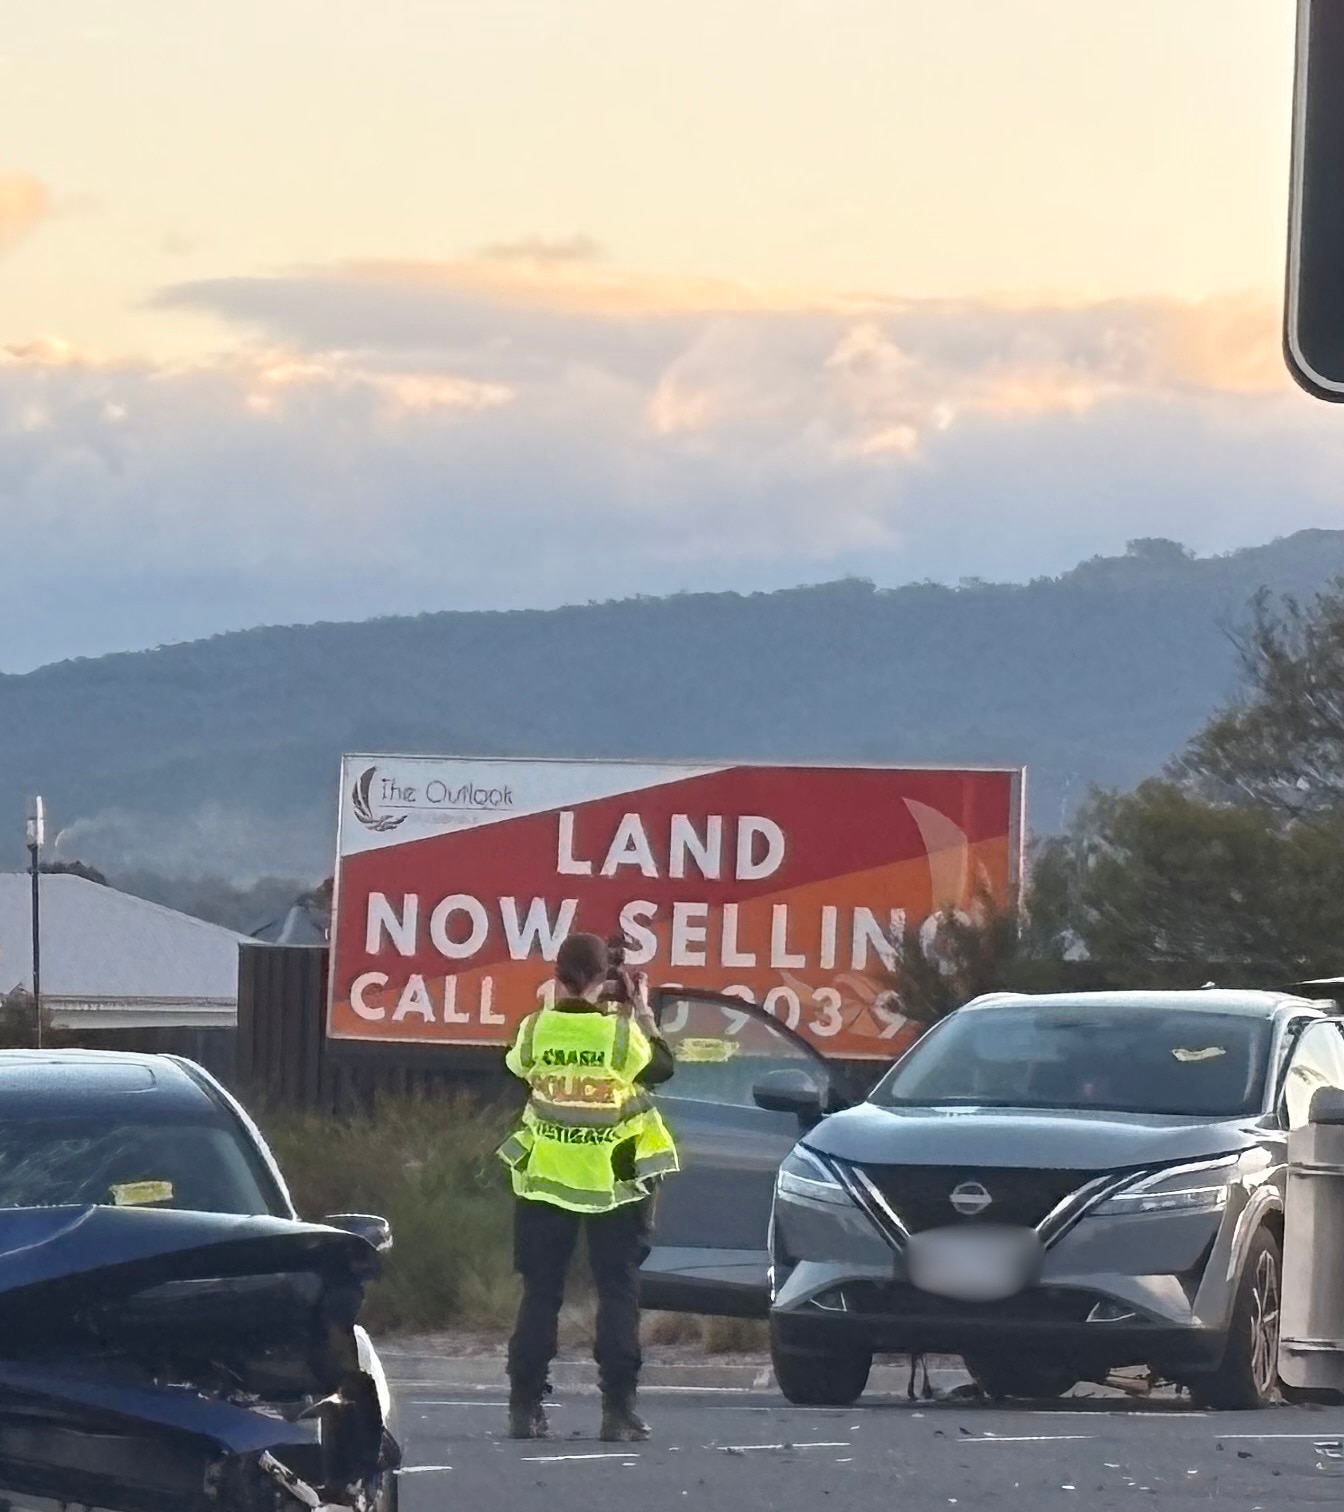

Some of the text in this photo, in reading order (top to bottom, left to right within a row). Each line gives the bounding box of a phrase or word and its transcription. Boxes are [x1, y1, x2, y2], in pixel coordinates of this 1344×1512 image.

[381, 778, 513, 806] The Outlook
[556, 810, 786, 881] LAND
[366, 892, 579, 960] NOW
[350, 971, 506, 1025] CALL
[542, 1048, 605, 1067] CRASH
